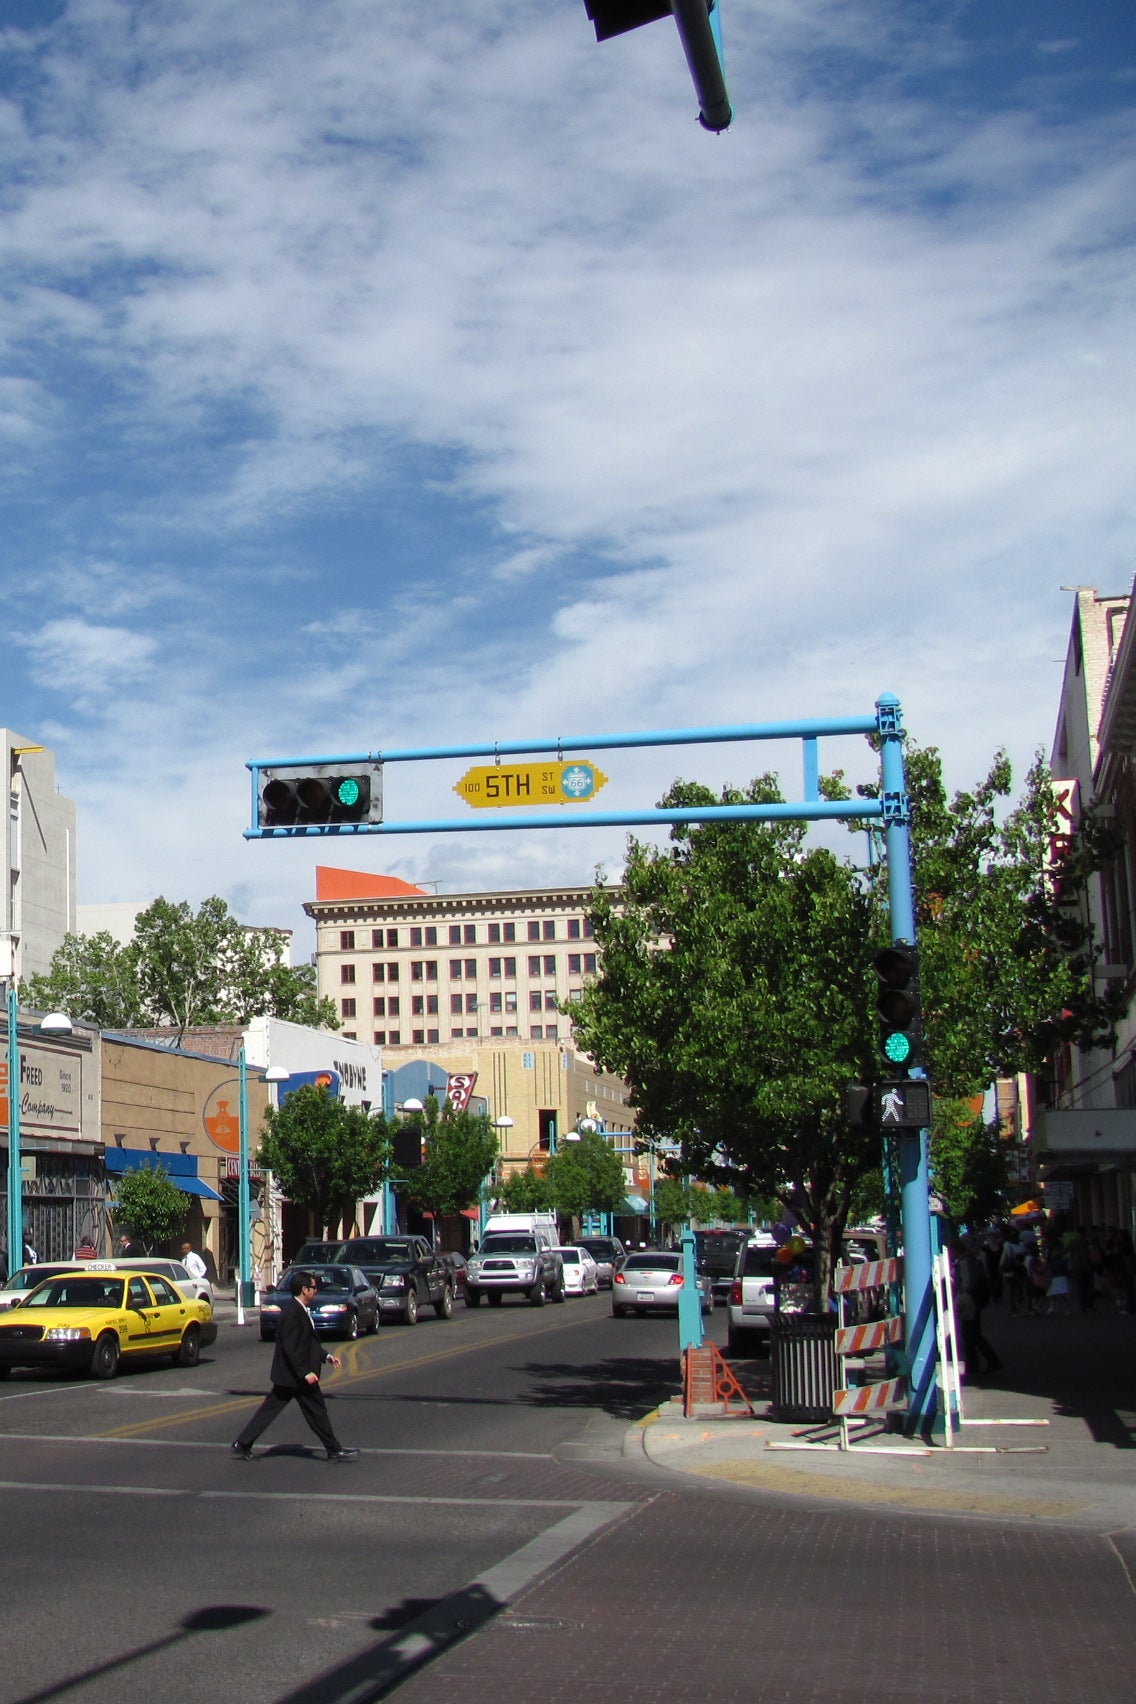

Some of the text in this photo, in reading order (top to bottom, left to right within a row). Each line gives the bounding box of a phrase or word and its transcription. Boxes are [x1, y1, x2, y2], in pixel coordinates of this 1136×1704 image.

[542, 772, 554, 781] ST
[464, 773, 530, 798] 100 5TH
[542, 785, 555, 795] SW
[21, 1092, 56, 1120] Company
